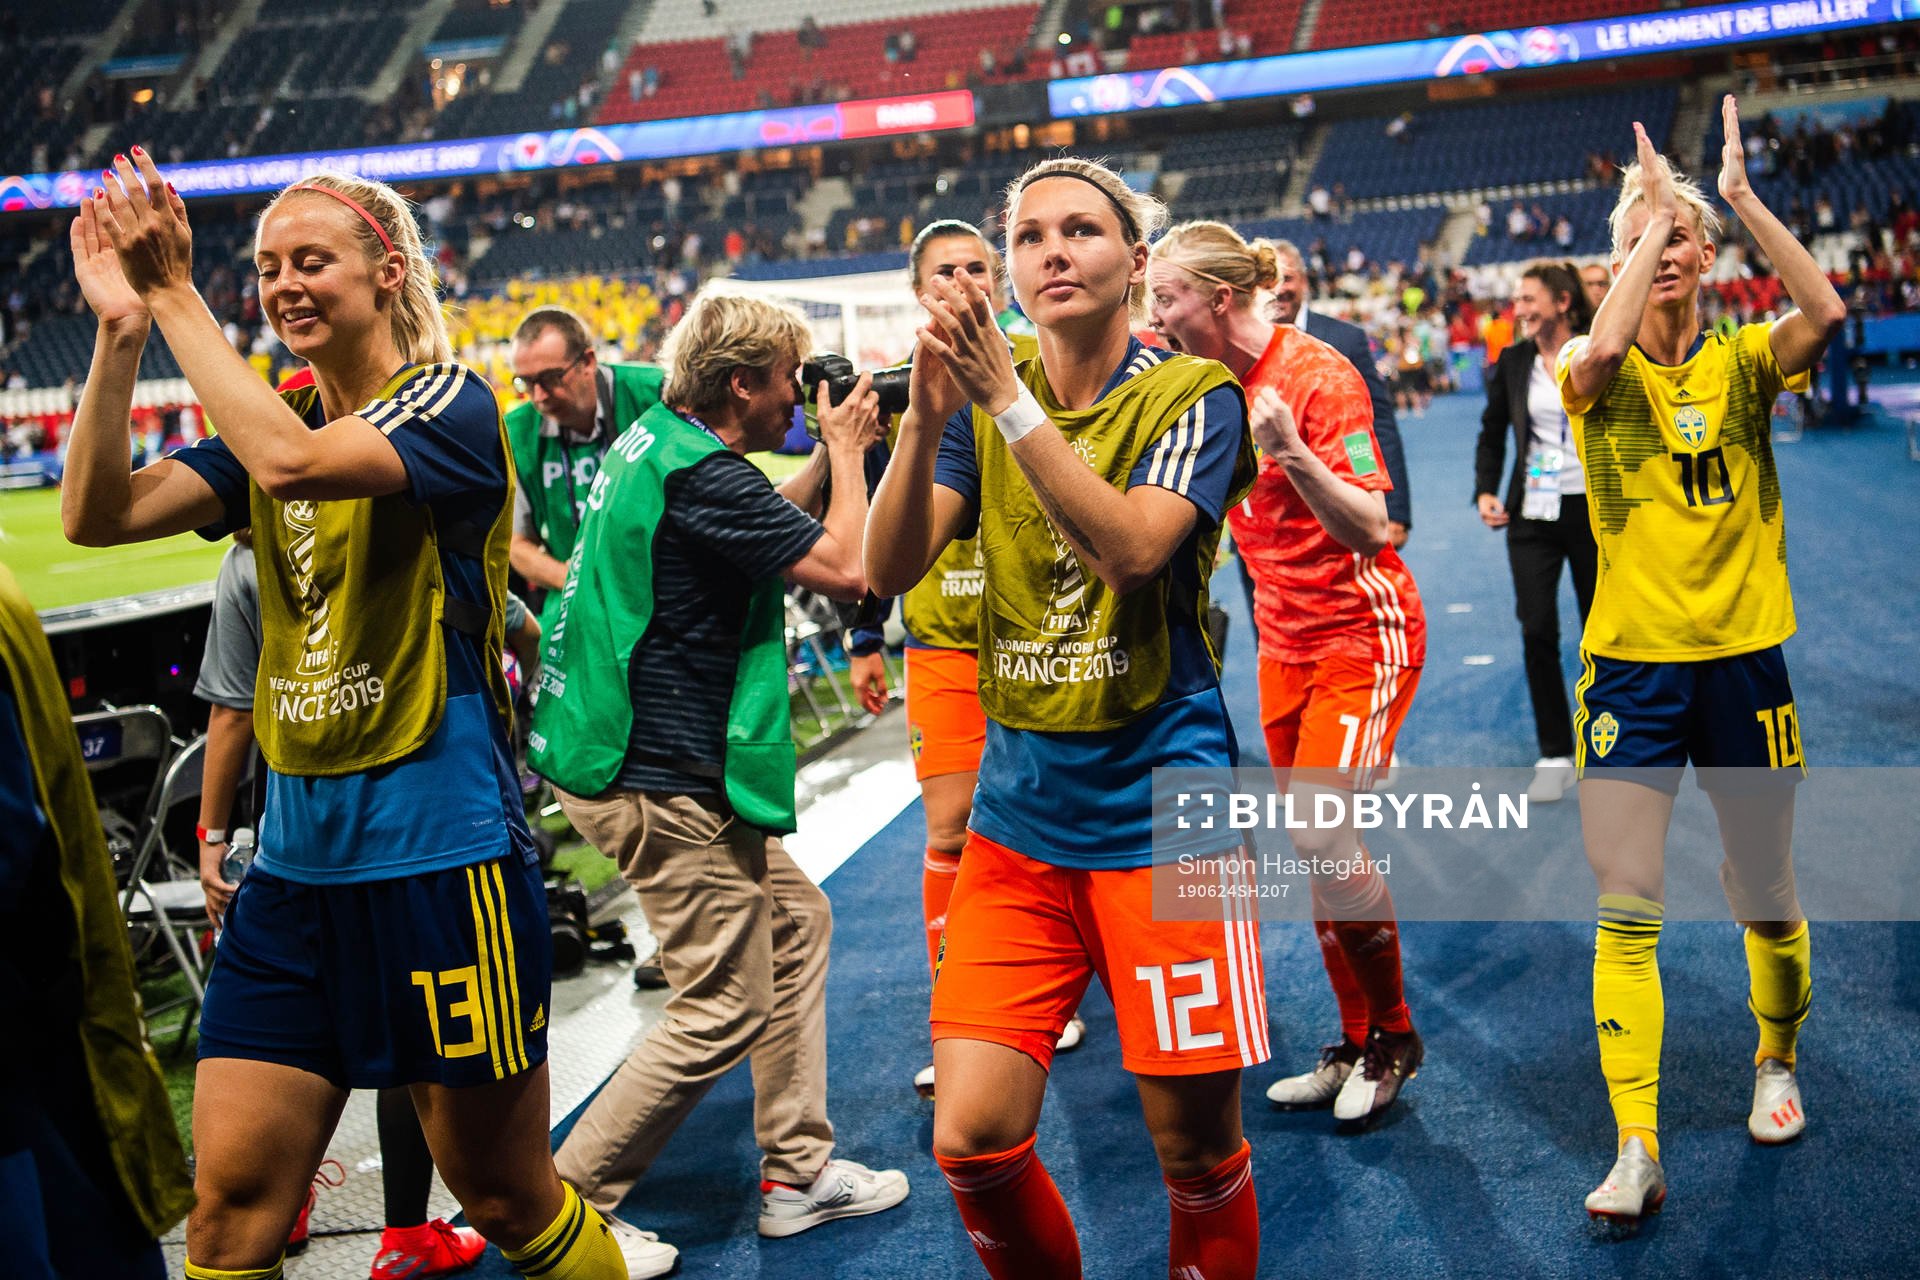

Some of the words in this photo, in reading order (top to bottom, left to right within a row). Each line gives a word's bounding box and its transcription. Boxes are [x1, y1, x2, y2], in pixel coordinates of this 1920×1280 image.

[1596, 24, 1628, 50] LE
[1629, 11, 1734, 47] MOMENT
[1736, 7, 1770, 35] DE
[1771, 0, 1868, 30] BRILLER
[1671, 445, 1735, 507] 10
[1049, 613, 1082, 629] FIFA
[305, 649, 329, 668] FIFA
[1097, 636, 1117, 649] CUP
[343, 662, 371, 679] CUP
[1083, 650, 1129, 680] 2019
[328, 676, 385, 716] 2019
[1757, 702, 1800, 770] 10
[411, 965, 487, 1058] 13
[1135, 958, 1224, 1052] 12
